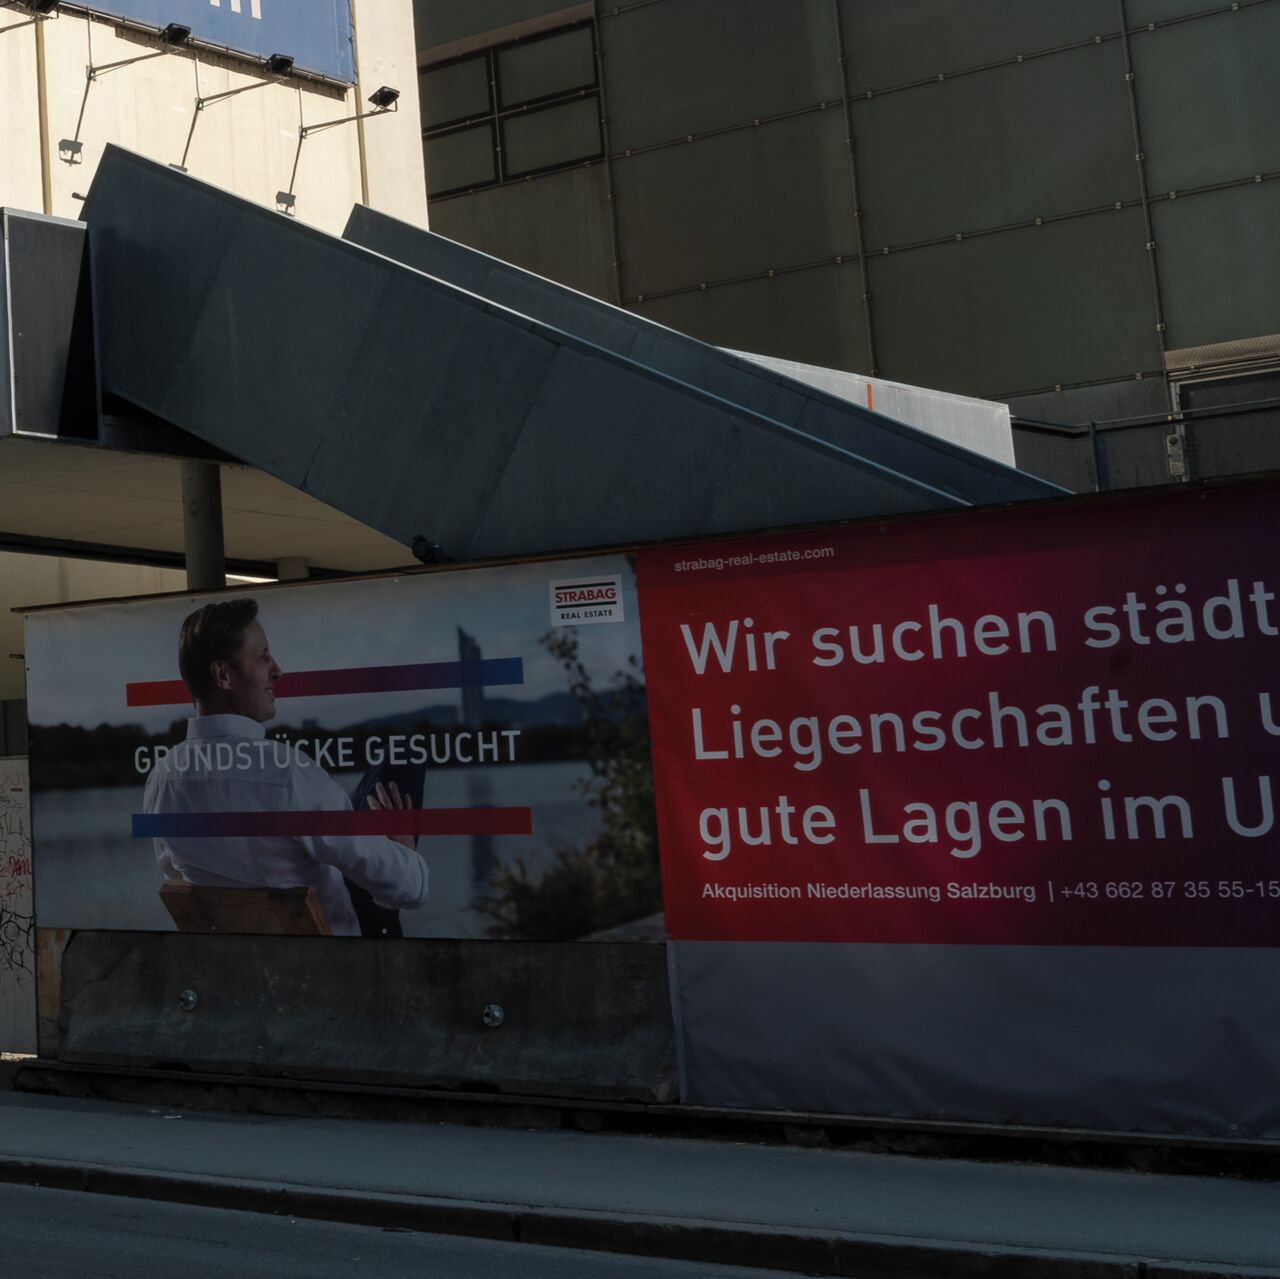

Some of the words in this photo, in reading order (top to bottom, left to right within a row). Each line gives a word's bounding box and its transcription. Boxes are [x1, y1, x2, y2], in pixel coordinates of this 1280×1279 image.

[673, 545, 835, 572] strabag-real-estate.com
[555, 587, 616, 604] STRABAG
[560, 612, 582, 620] REAL
[584, 609, 614, 618] ESTATE
[680, 617, 790, 675] Wir
[811, 604, 1057, 667] suchen
[1083, 578, 1279, 649] städt
[691, 685, 1230, 772] Liegenschaften
[365, 729, 522, 767] GESUCHT
[698, 794, 836, 861] gute
[859, 788, 1073, 859] Lagen
[1097, 779, 1194, 841] im
[1222, 775, 1274, 838] U
[701, 881, 802, 903] Akquisition
[806, 880, 940, 903] Niederlassung
[946, 881, 1036, 903] Salzburg
[1060, 882, 1100, 899] +43
[1104, 881, 1144, 899] 662
[1150, 881, 1176, 899] 87
[1183, 881, 1211, 899] 35
